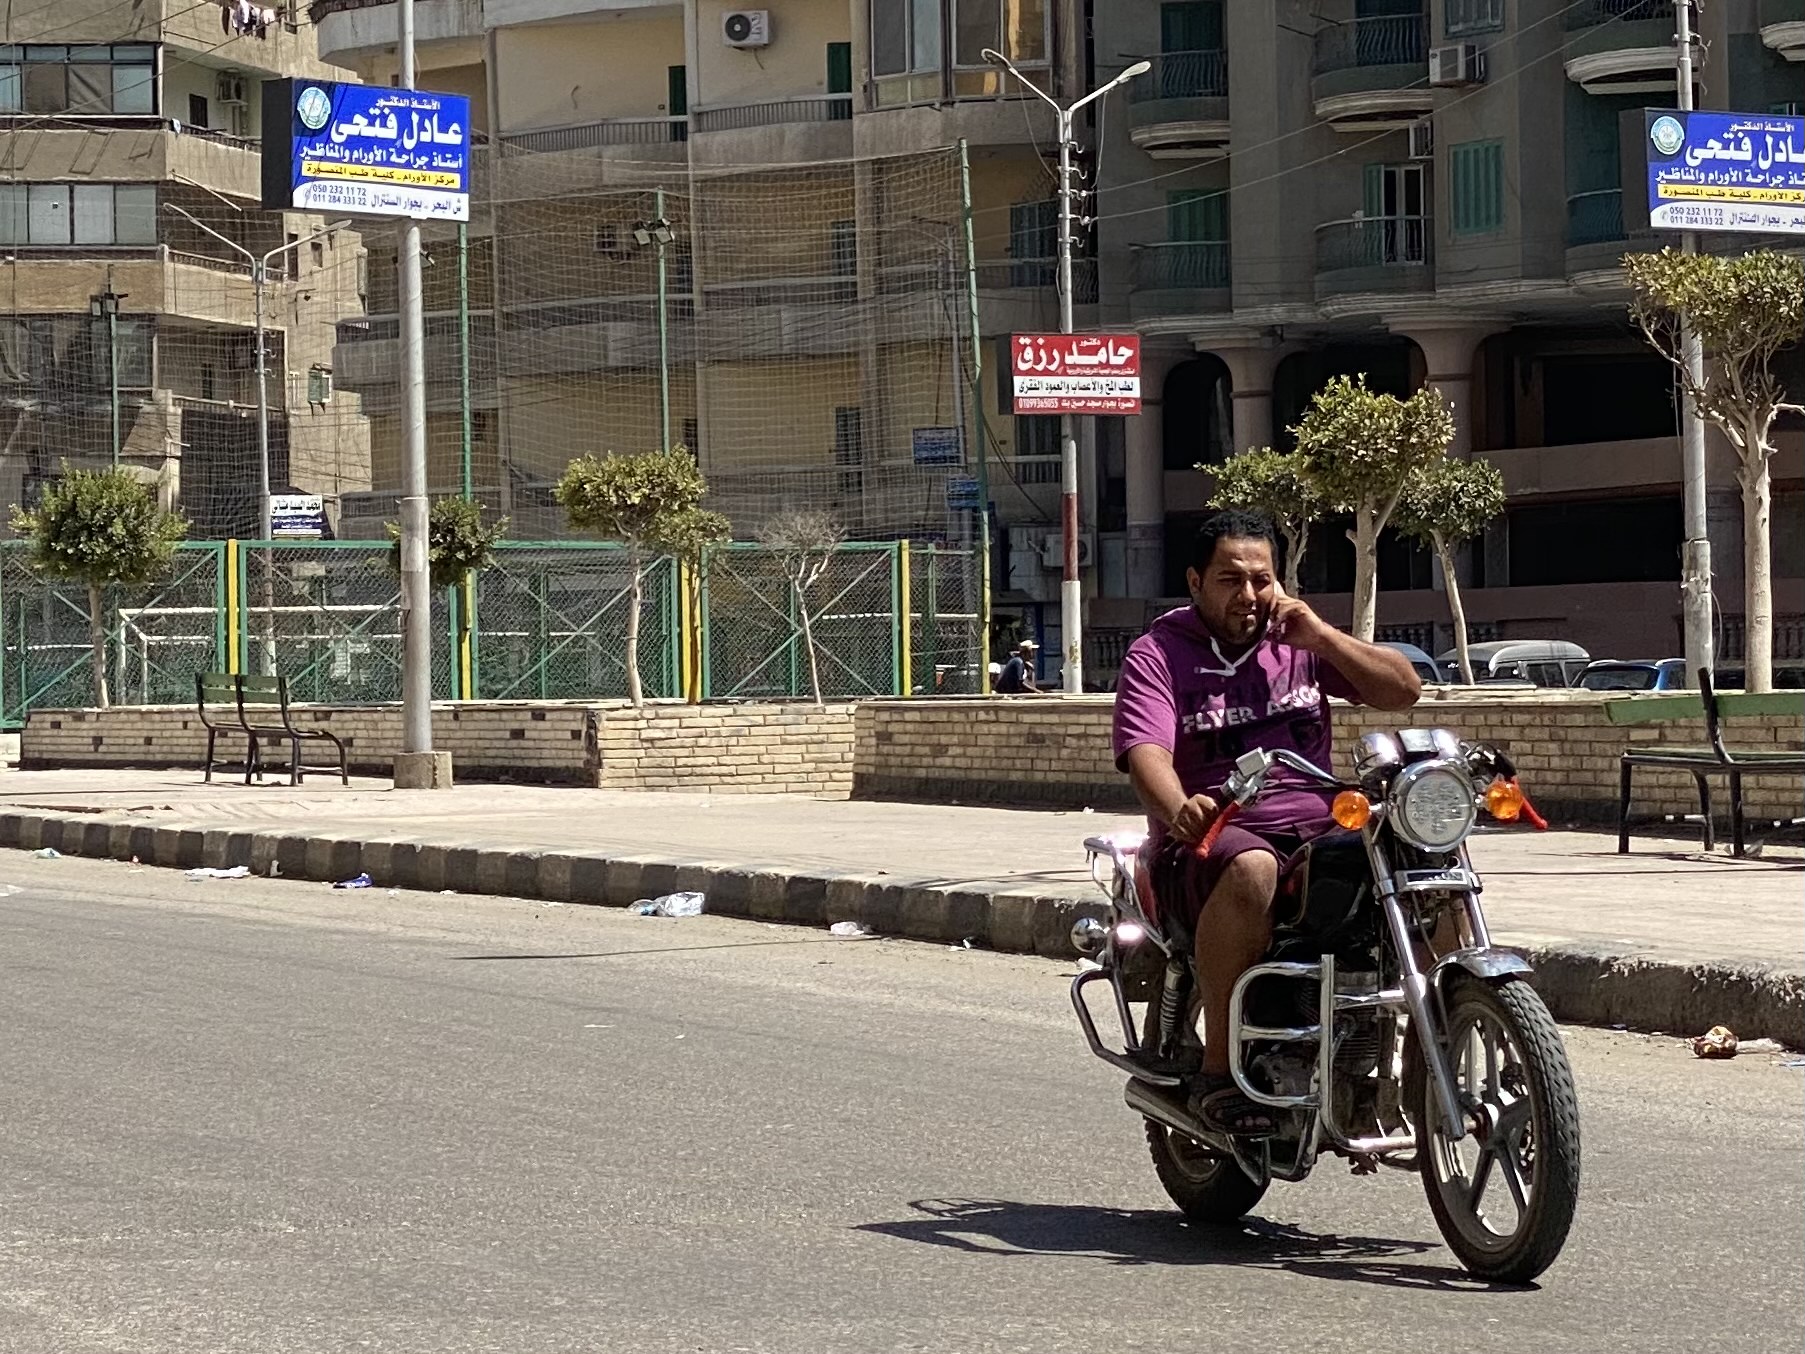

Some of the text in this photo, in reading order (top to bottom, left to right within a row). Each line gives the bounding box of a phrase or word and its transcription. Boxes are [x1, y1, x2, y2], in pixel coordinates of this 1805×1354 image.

[330, 106, 398, 144] فتحى
[402, 110, 463, 150] عادل
[299, 143, 350, 163] والمناظير
[1685, 131, 1752, 167] فتحى
[1758, 134, 1805, 170] ادل
[389, 147, 429, 170] جراحة
[306, 162, 347, 176] المنصورة
[1655, 166, 1705, 183] والمناظير
[434, 173, 455, 186] مركز
[1745, 169, 1785, 187] جراحة
[312, 184, 367, 196] 050 232 11 72
[1663, 186, 1703, 197] المنصورة
[312, 194, 326, 203] 011
[327, 195, 342, 204] 284
[356, 197, 367, 206] 22
[1669, 206, 1723, 216] 050 232 11 72
[1670, 216, 1683, 225] 011
[1685, 217, 1699, 225] 284
[1714, 218, 1724, 226] 22
[1017, 337, 1134, 371] حامد رزق
[1045, 379, 1070, 394] والعمود
[1182, 706, 1258, 734] FLYER
